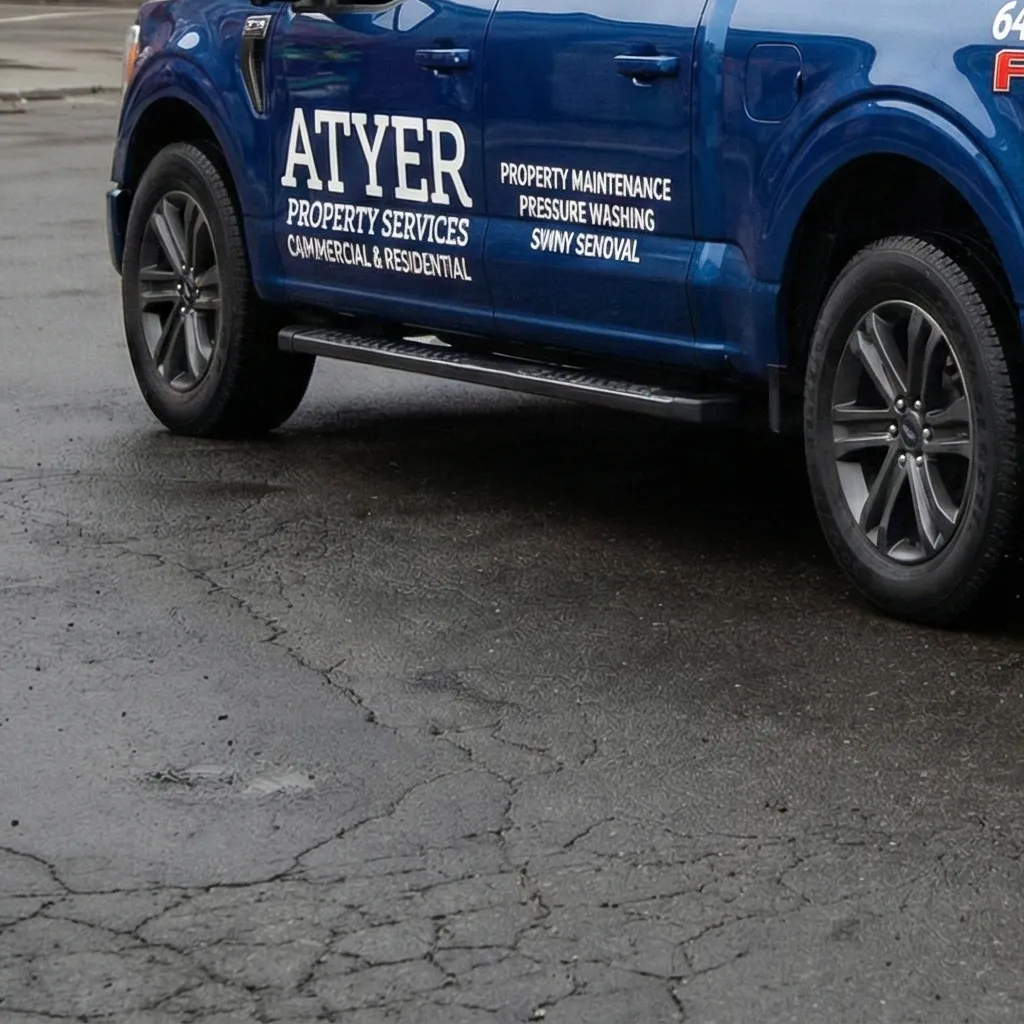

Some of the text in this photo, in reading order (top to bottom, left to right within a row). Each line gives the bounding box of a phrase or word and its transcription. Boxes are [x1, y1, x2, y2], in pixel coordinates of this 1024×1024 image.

[281, 107, 473, 208] ATYER
[500, 162, 672, 201] PROPERTY MAINTENANCE
[286, 197, 470, 247] PROPERTY SERVICES
[519, 195, 656, 232] PRESSURE WASHING
[372, 245, 383, 269] &
[384, 247, 472, 281] RESIDENTIAL
[575, 232, 640, 263] SENOVAL
